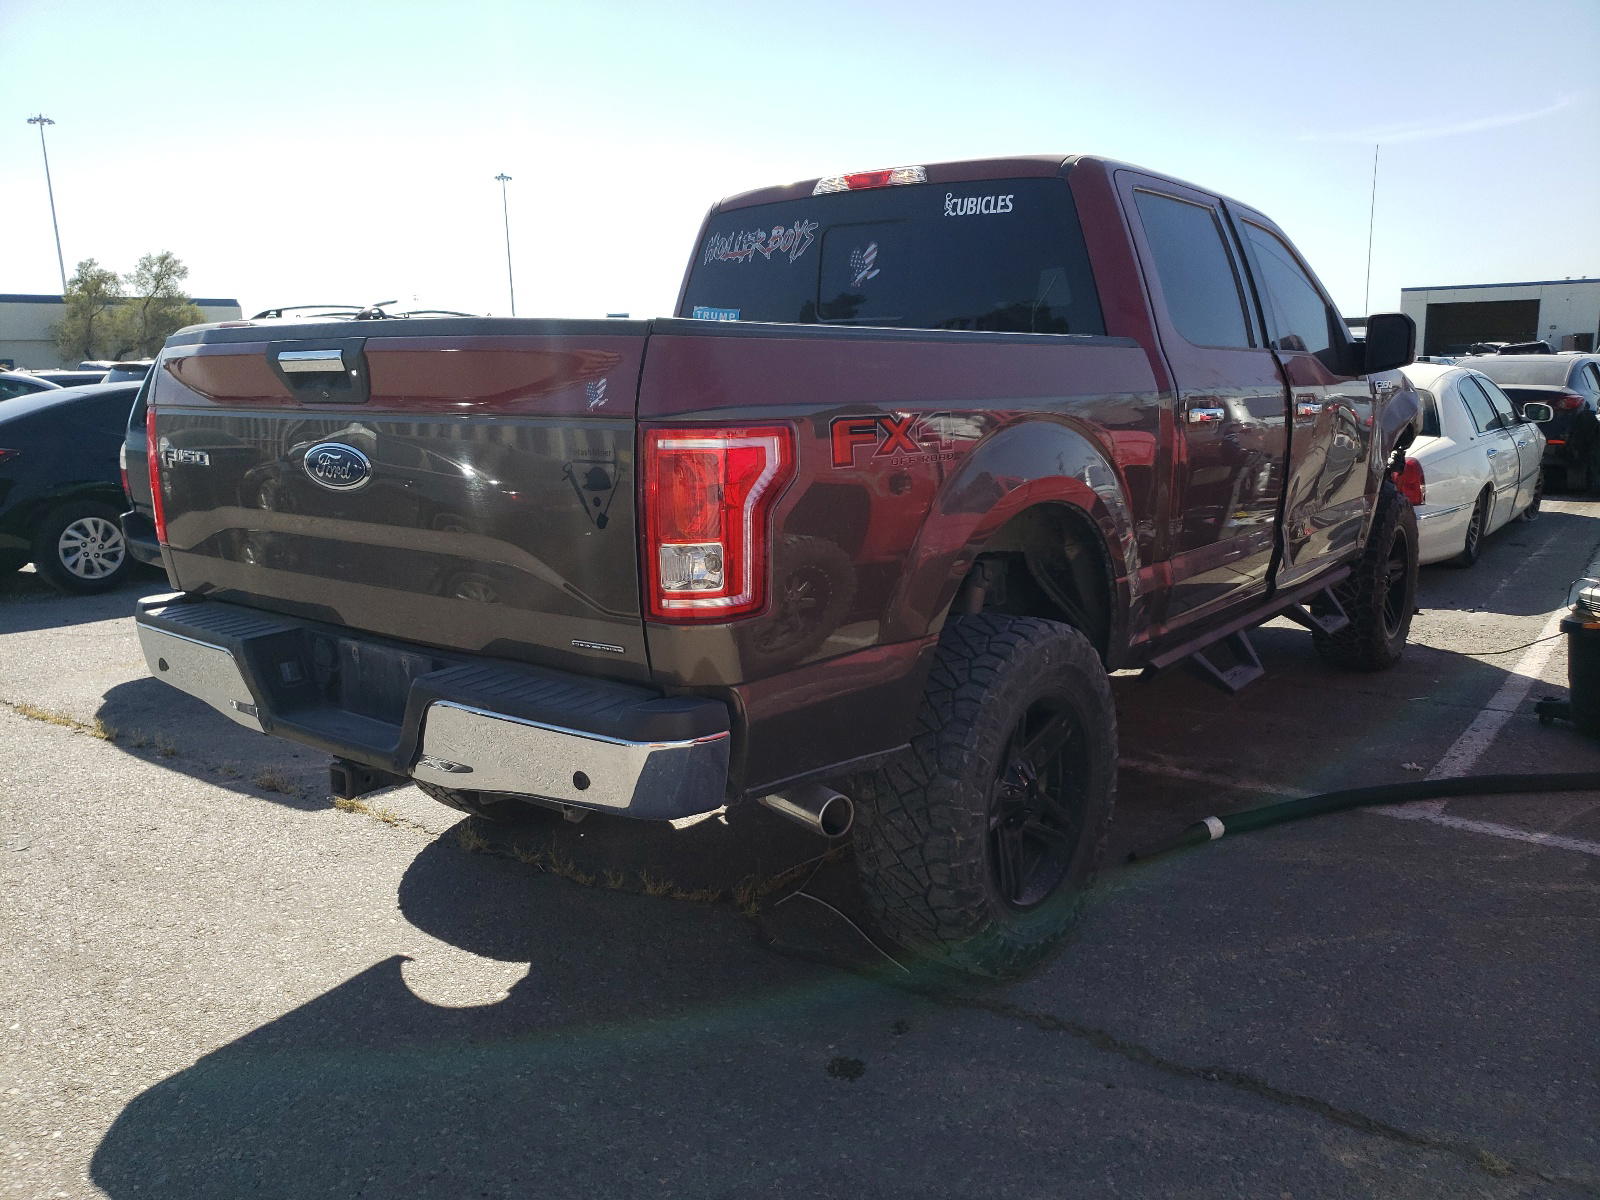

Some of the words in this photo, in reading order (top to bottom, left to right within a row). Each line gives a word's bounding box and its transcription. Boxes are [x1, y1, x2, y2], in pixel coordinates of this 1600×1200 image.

[949, 194, 1014, 217] CUBICLES
[768, 219, 819, 264] BOYS
[696, 310, 736, 321] TRUMP
[829, 411, 955, 470] FX4
[315, 452, 352, 480] Ford
[891, 456, 917, 466] OFF
